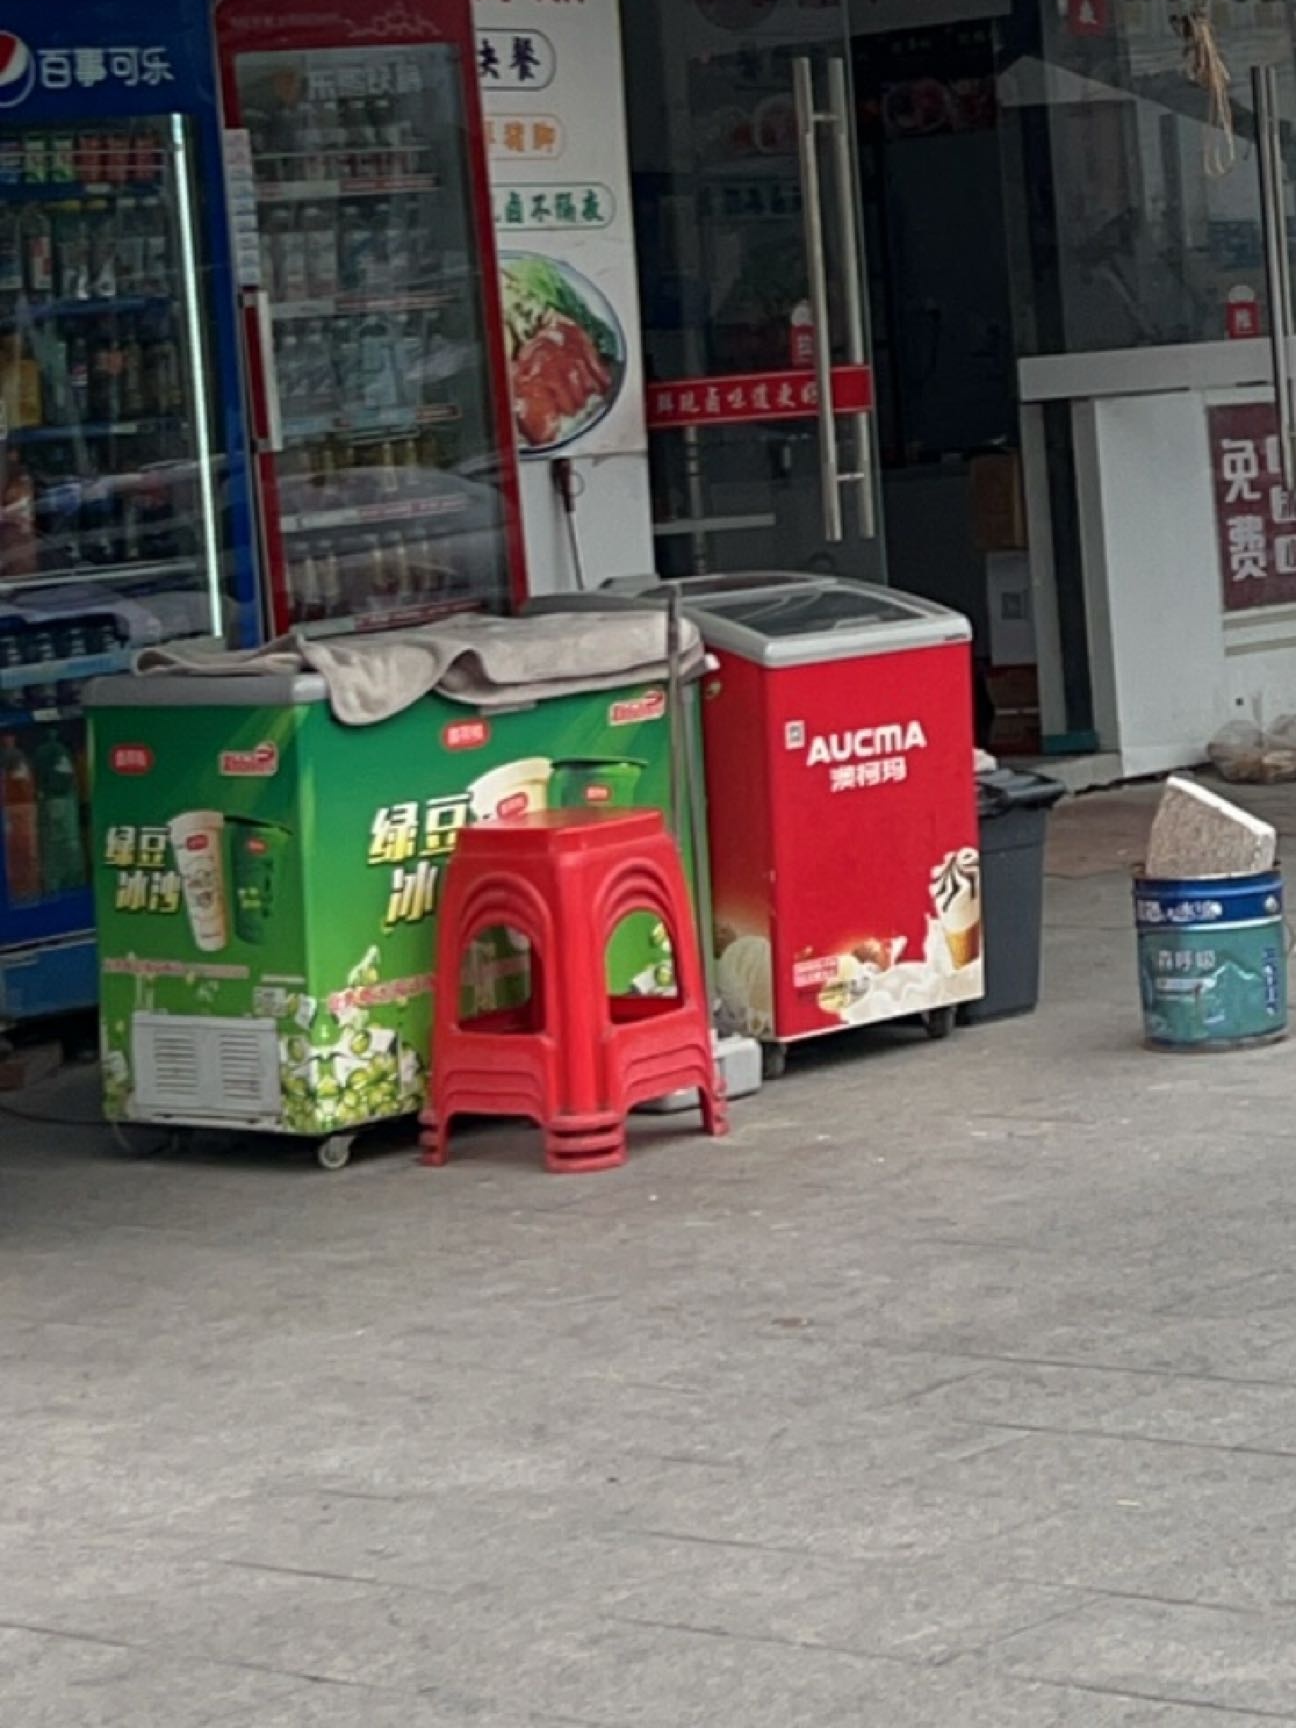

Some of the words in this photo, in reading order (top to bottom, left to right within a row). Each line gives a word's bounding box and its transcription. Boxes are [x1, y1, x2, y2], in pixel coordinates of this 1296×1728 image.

[37, 46, 175, 89] 百事可乐
[496, 188, 606, 224] 卤不隔夜
[1221, 438, 1268, 582] 免费
[806, 720, 927, 766] AUCMA
[829, 755, 908, 792] 澳柯玛
[104, 826, 168, 868] 绿豆
[367, 791, 474, 865] 绿豆
[114, 870, 182, 914] 冰沙
